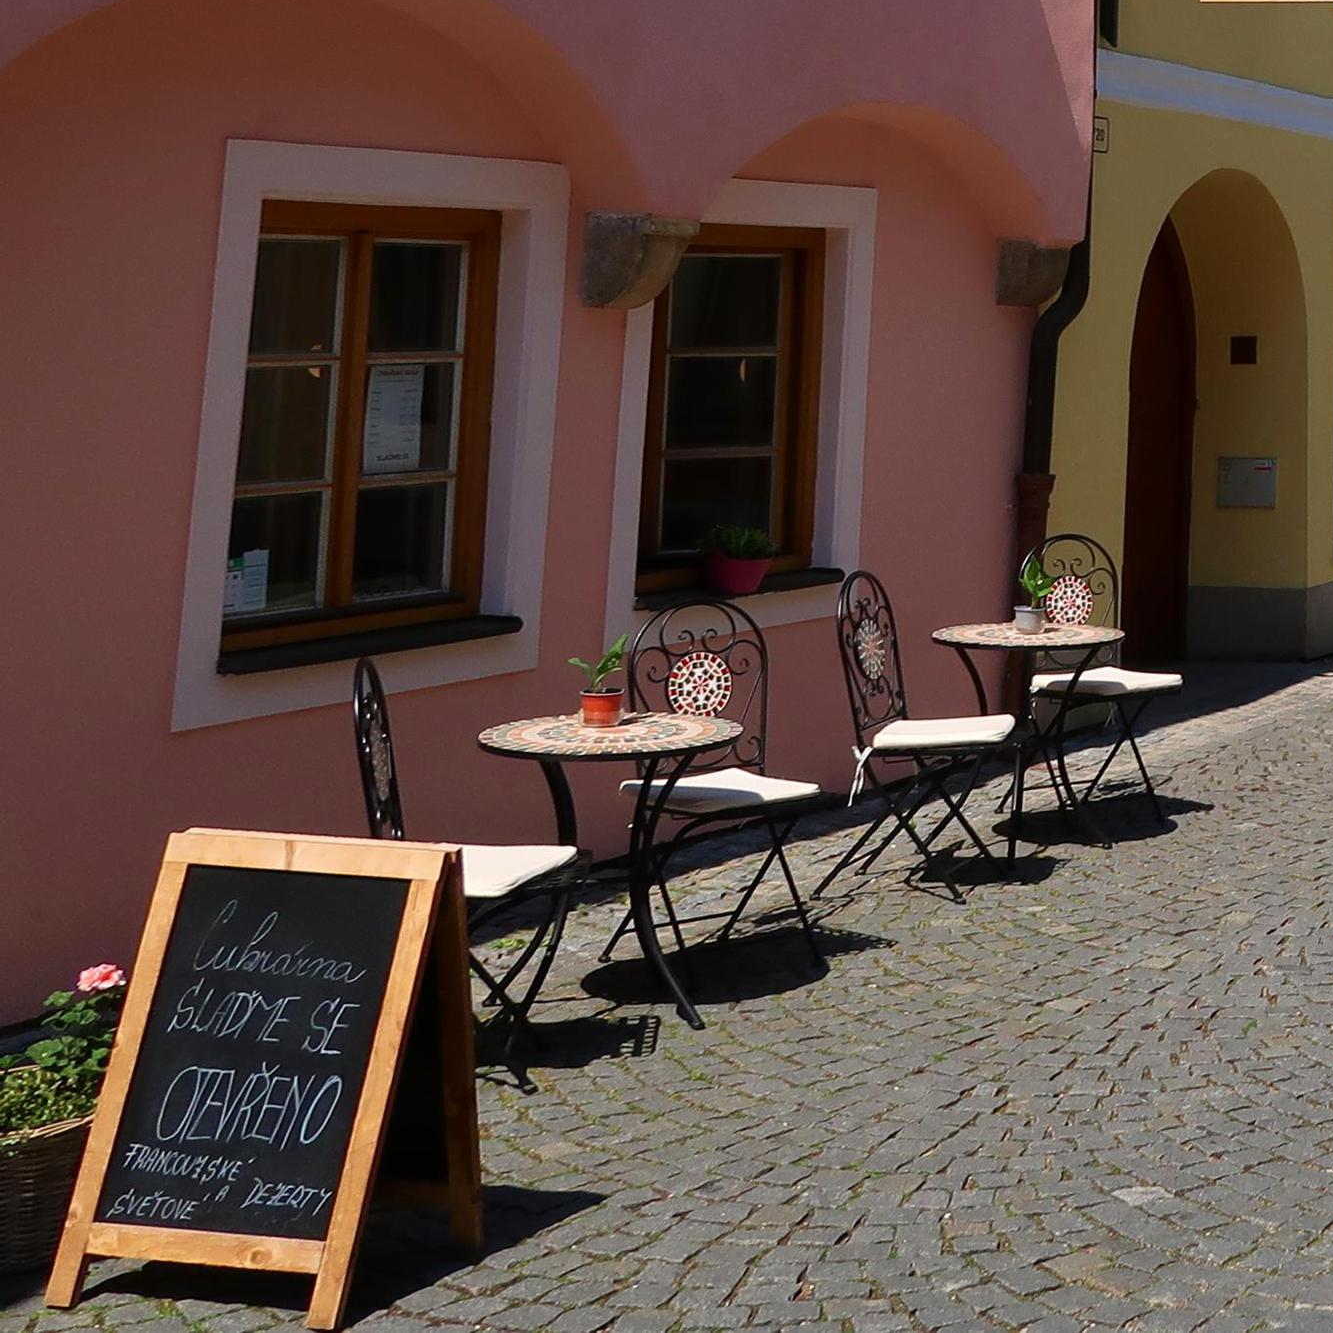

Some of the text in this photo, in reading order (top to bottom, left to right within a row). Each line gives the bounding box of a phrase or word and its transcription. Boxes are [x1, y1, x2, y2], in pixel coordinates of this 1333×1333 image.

[193, 899, 367, 984] Cukrárna
[302, 997, 360, 1055] SE
[156, 1061, 343, 1151] OTEVŘENO
[240, 1177, 333, 1217] DEZERTY
